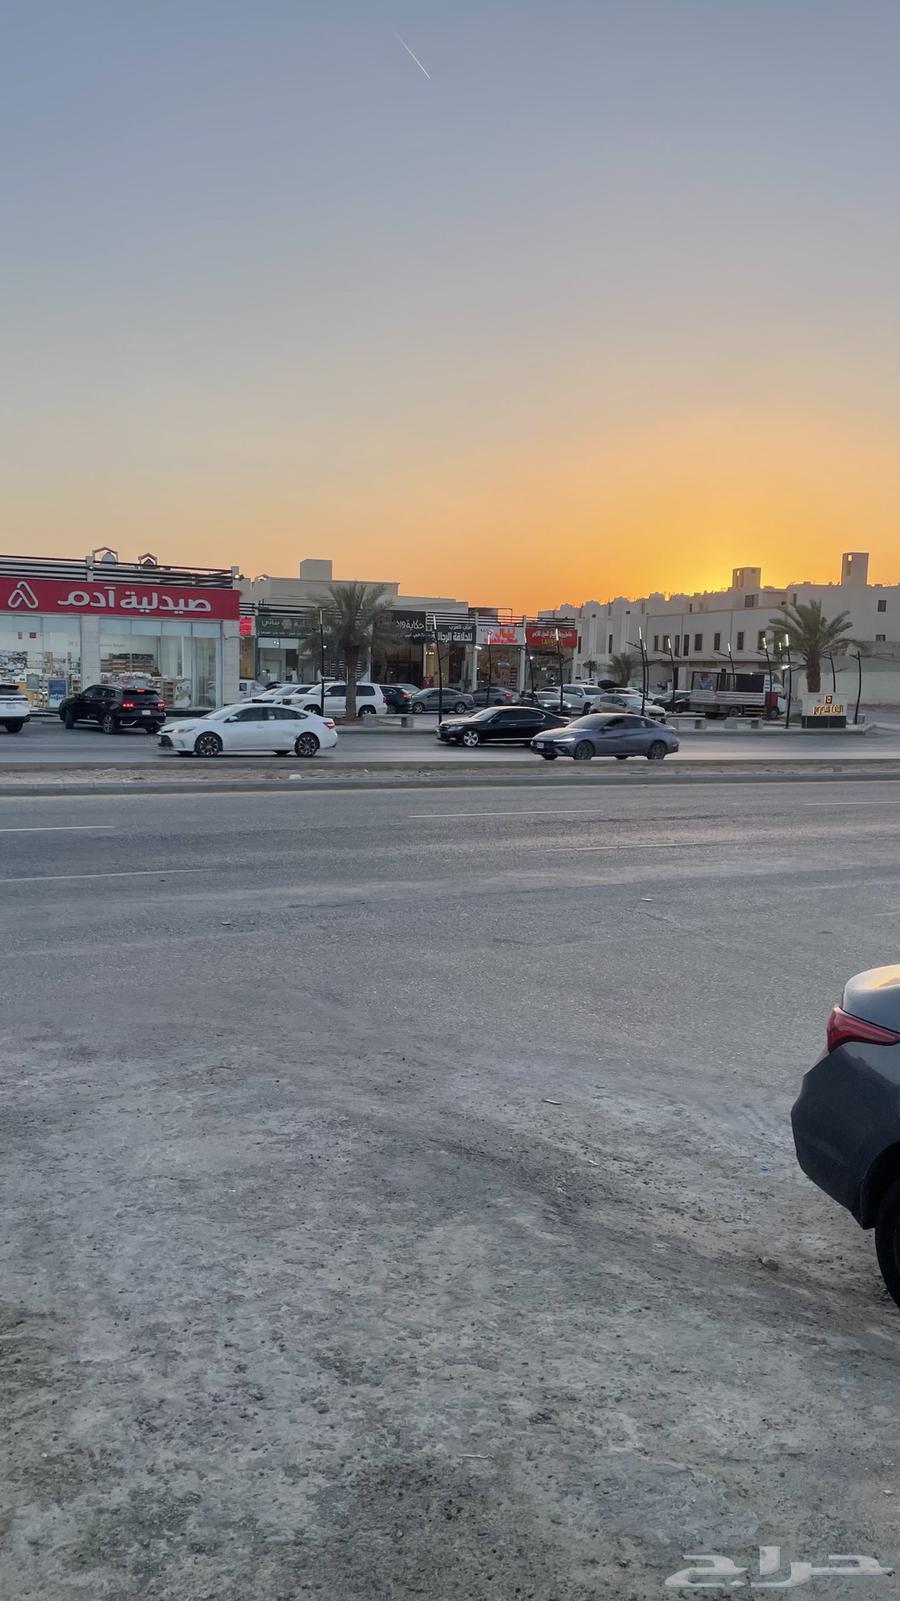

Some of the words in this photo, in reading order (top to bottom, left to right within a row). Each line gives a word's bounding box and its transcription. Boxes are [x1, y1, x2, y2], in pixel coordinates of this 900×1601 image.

[57, 586, 117, 608] آدم
[120, 591, 212, 614] صيدلية
[405, 619, 425, 631] حكاية
